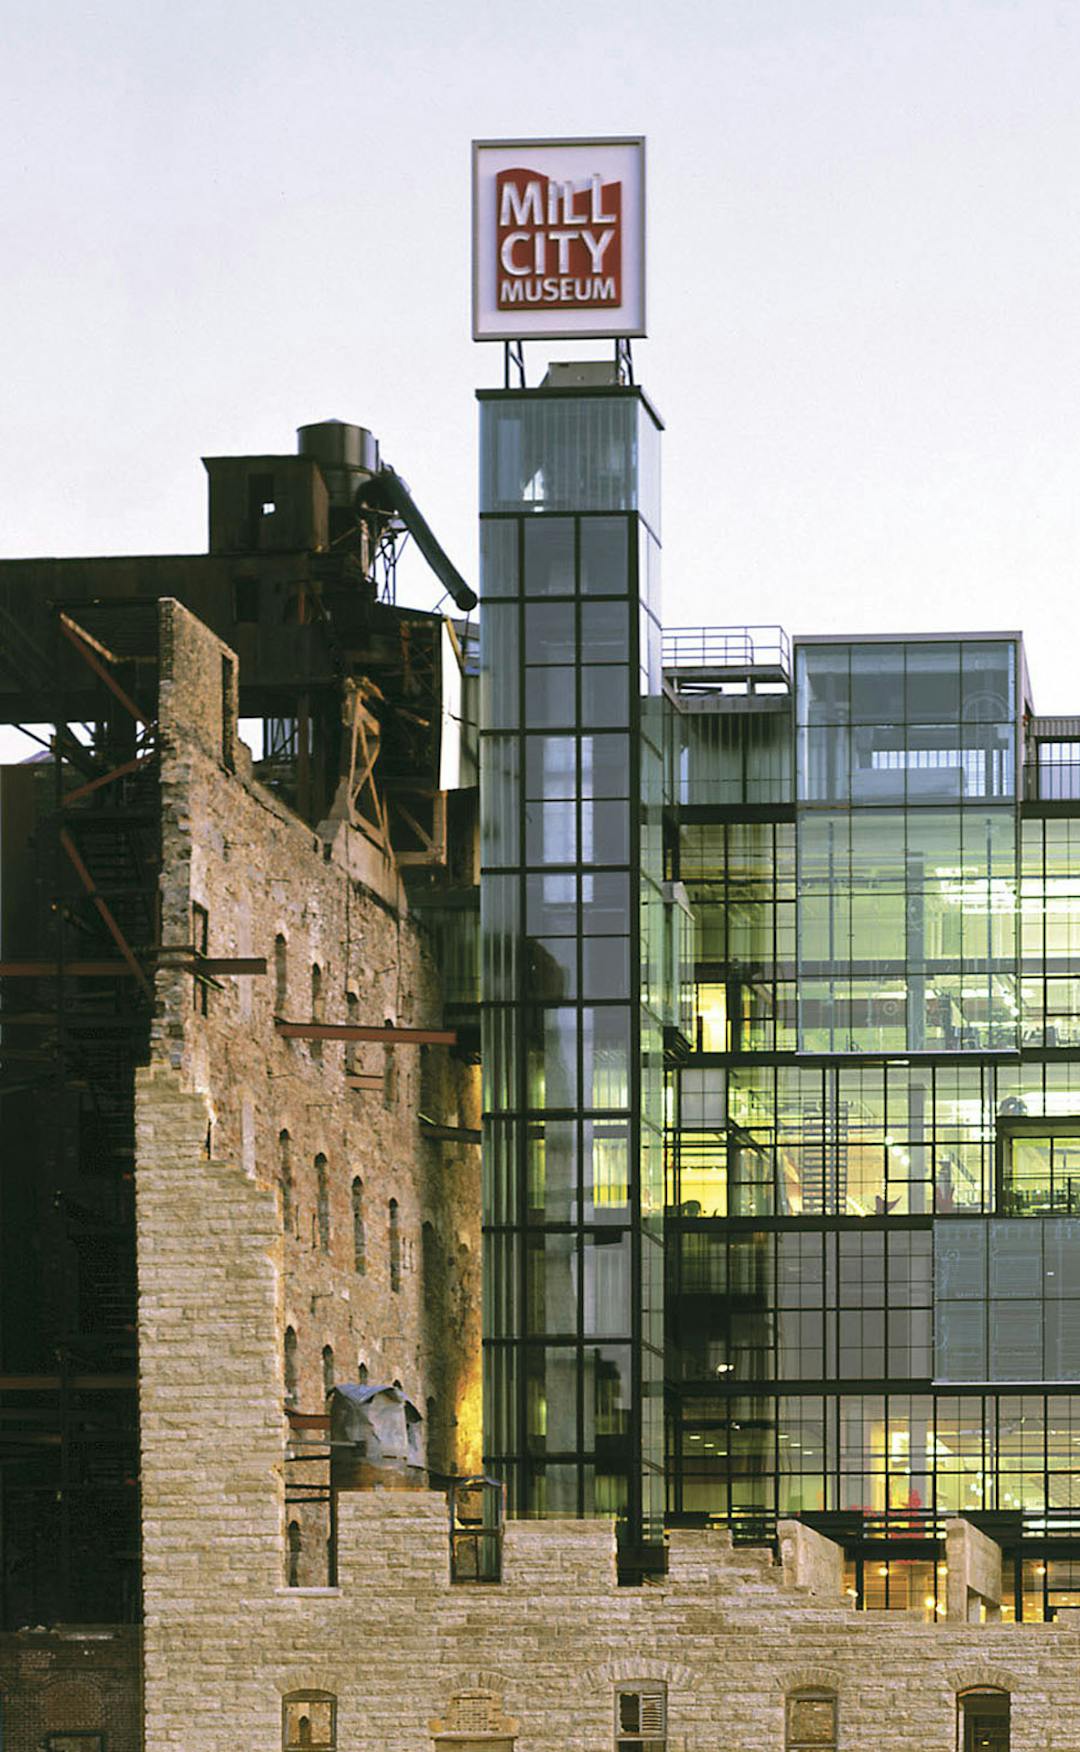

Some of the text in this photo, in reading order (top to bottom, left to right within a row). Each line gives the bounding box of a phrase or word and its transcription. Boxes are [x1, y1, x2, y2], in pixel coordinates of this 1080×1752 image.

[500, 173, 616, 226] MILL
[501, 229, 615, 276] CITY
[500, 277, 616, 302] MUSEUM
